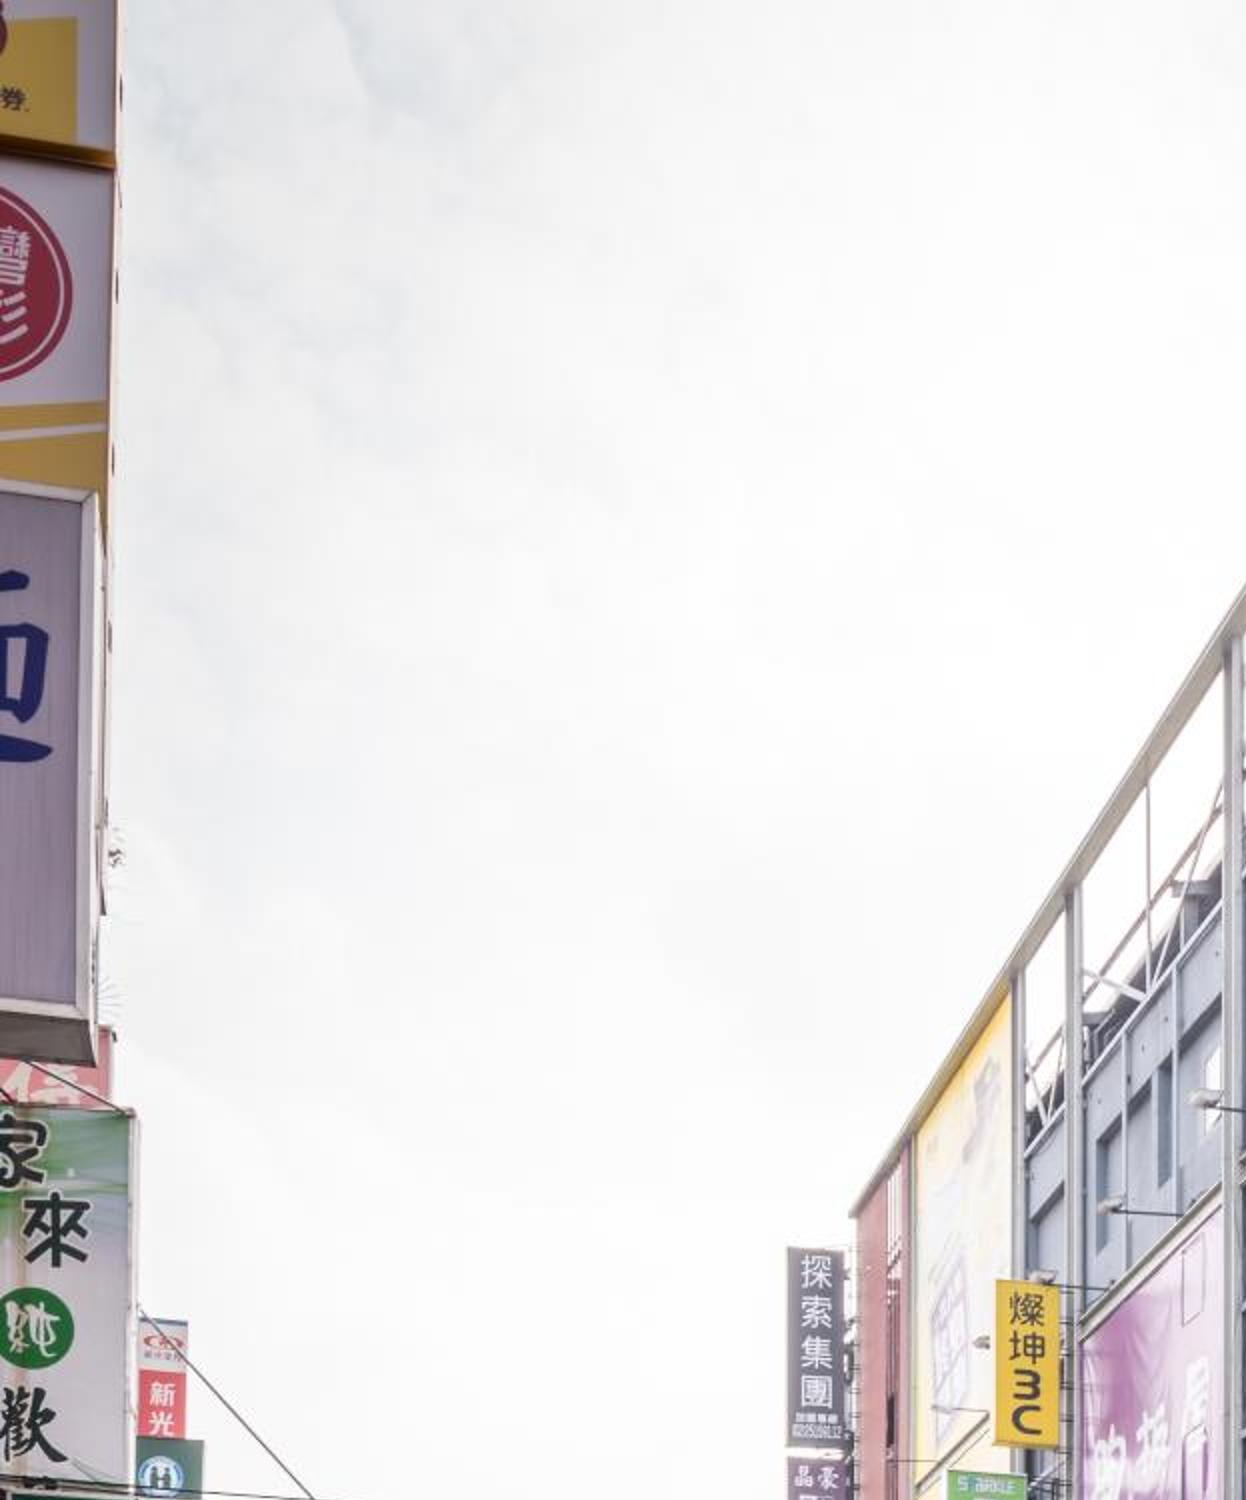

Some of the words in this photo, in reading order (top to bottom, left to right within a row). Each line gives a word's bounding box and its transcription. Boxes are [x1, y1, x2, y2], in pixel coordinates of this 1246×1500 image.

[800, 1256, 832, 1408] 探索集團
[1010, 1294, 1045, 1435] 燦坤3C
[794, 1466, 839, 1489] 晶豪
